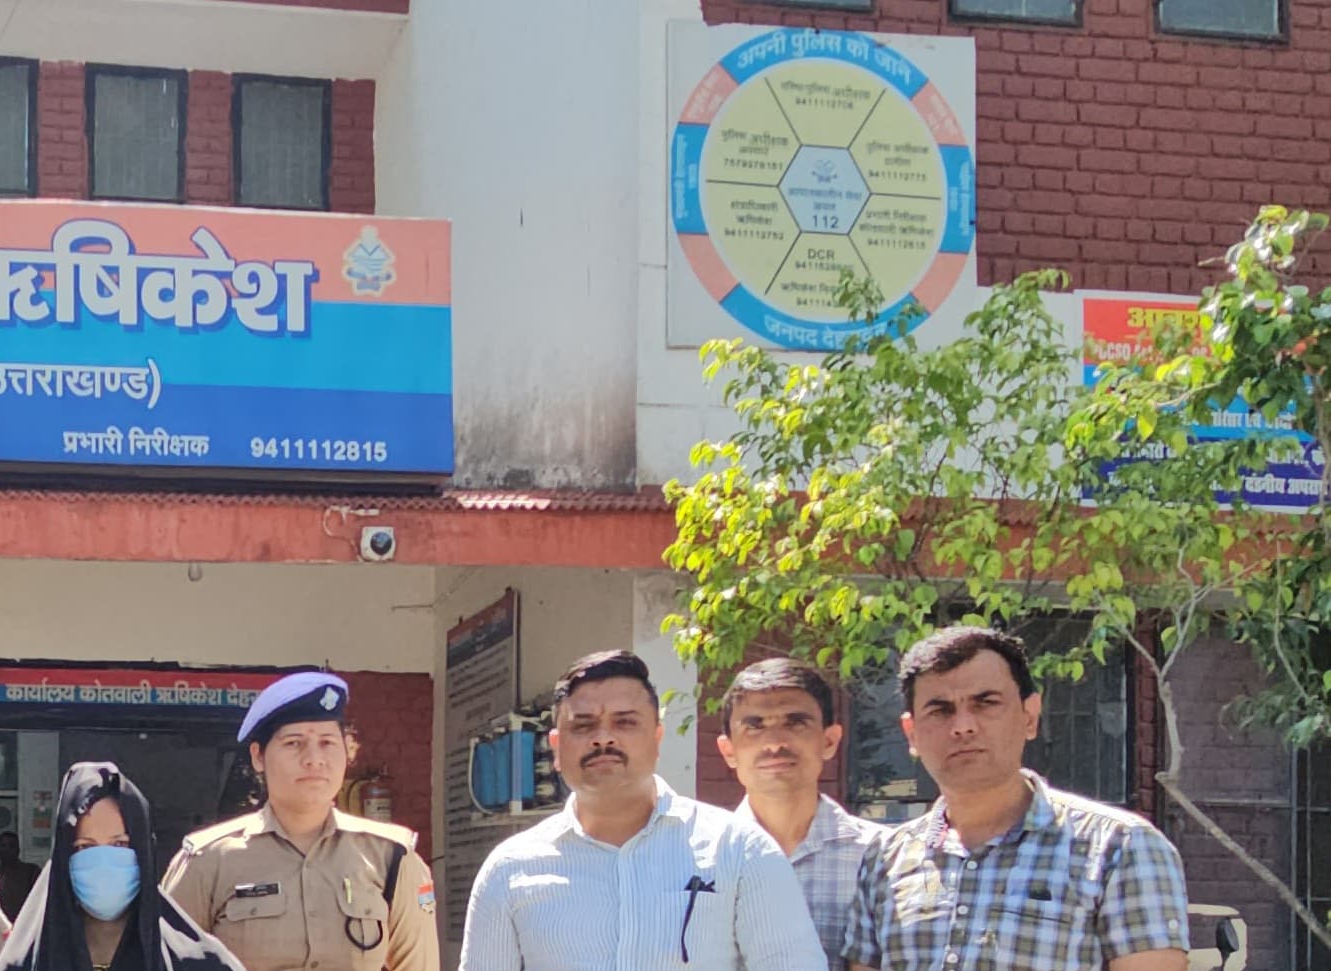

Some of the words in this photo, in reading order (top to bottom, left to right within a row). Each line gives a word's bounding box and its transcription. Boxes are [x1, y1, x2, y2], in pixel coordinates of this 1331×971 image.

[791, 28, 841, 57] पुलिस
[846, 32, 869, 61] को
[812, 215, 839, 229] 112
[807, 248, 835, 260] DCR
[62, 426, 123, 455] प्रभारी
[128, 427, 210, 457] निरीक्षक
[250, 437, 388, 463] 9411112815
[5, 677, 75, 702] कार्यालय
[79, 679, 152, 704] कोतवाली
[156, 681, 222, 706] ऋषिकेश
